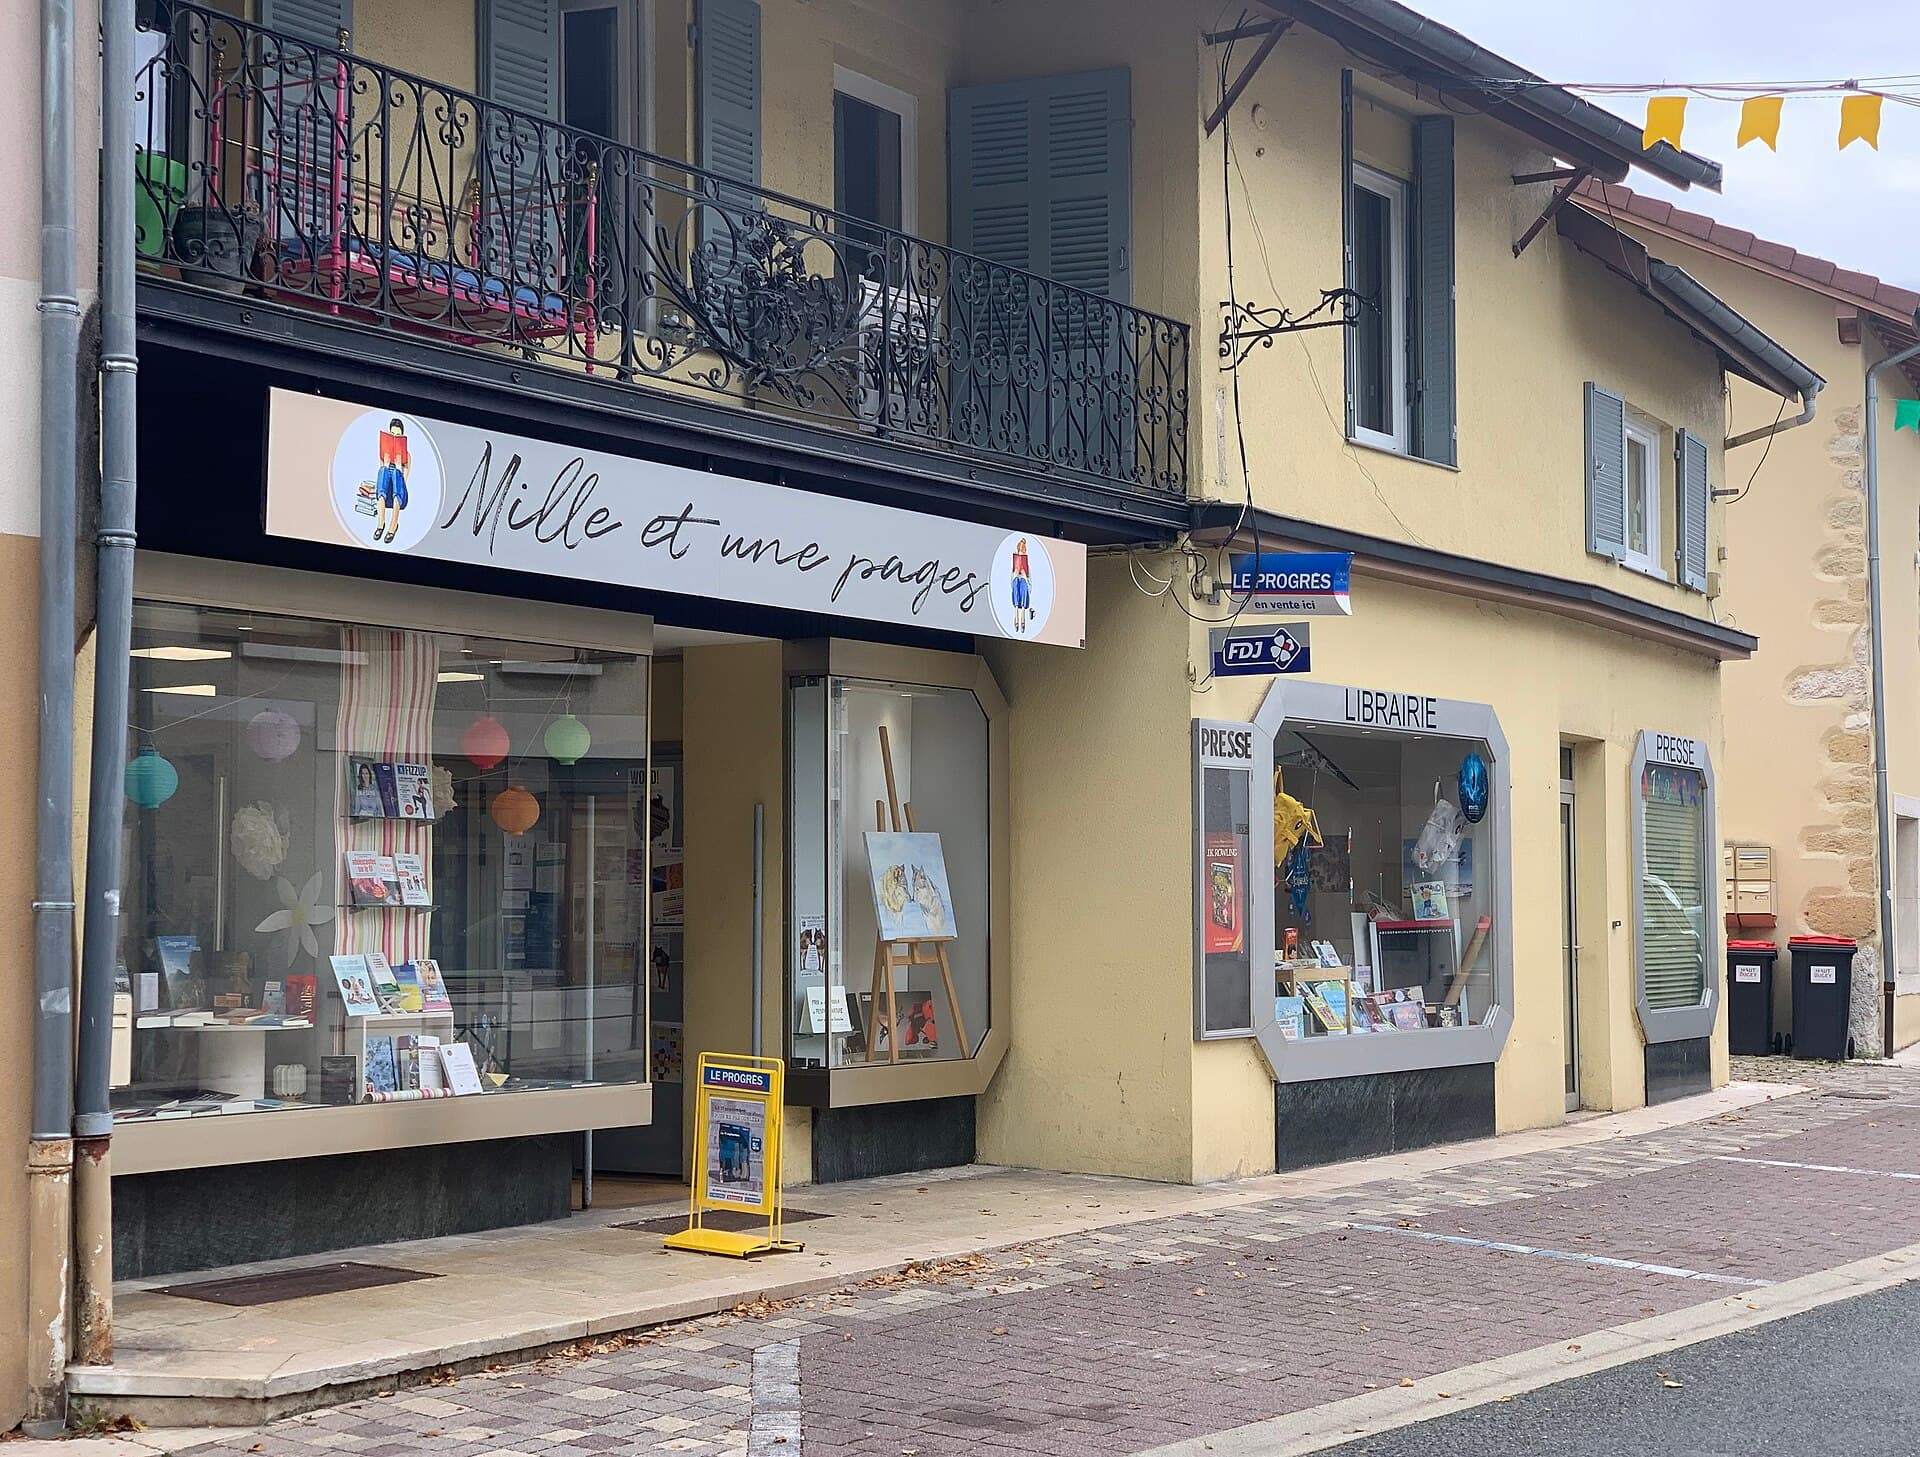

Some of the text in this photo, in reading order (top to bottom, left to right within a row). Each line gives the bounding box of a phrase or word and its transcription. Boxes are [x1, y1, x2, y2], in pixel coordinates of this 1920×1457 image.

[441, 440, 991, 617] Mille et une pages
[1232, 573, 1251, 589] LE
[1254, 600, 1316, 610] en vente ici
[1228, 641, 1263, 660] FDJ
[1345, 688, 1437, 729] LIBRAIRIE
[1201, 727, 1252, 759] PRESSE
[1656, 734, 1695, 765] PRESSE
[630, 769, 659, 785] WOD!
[710, 1070, 720, 1081] LE
